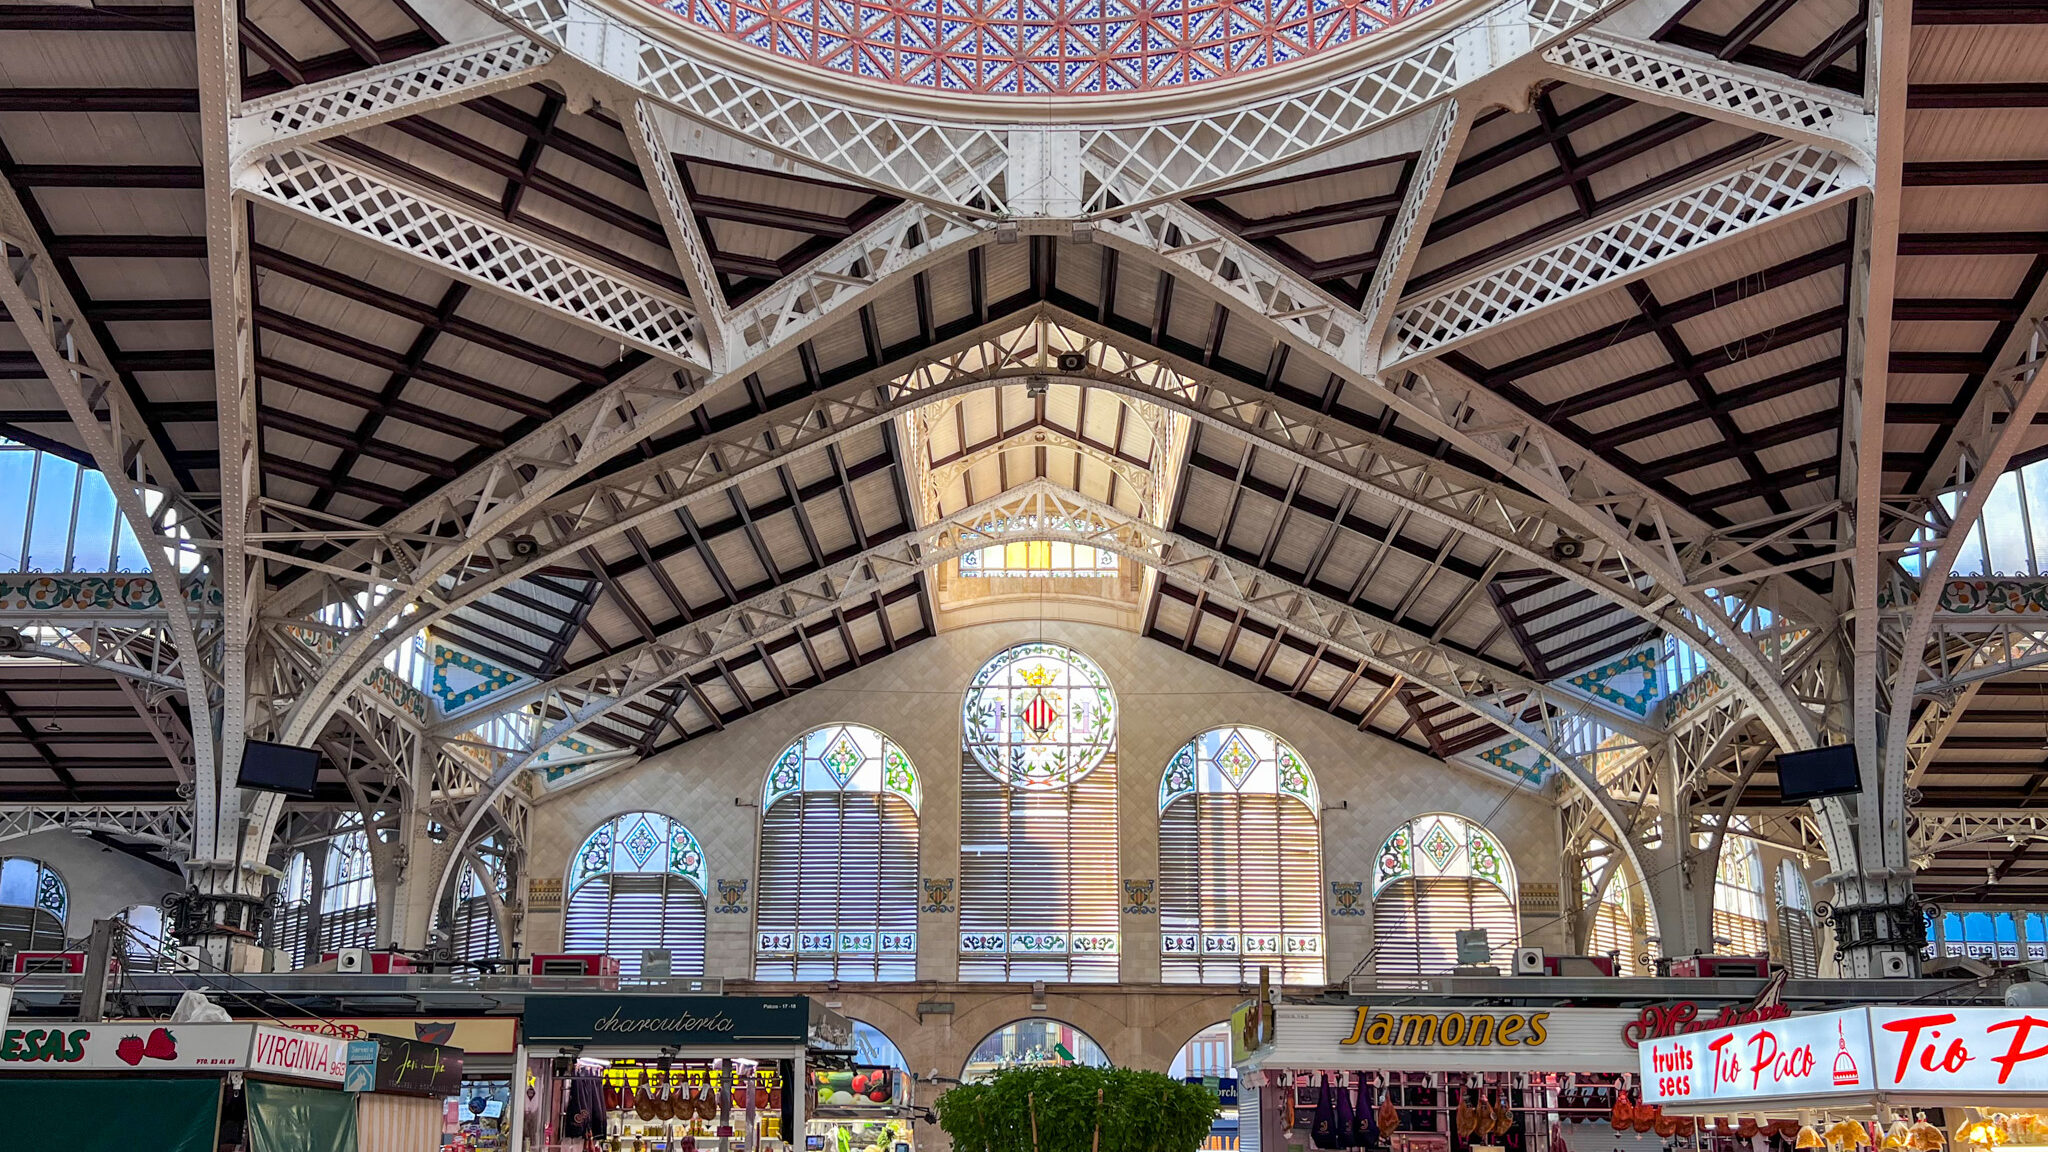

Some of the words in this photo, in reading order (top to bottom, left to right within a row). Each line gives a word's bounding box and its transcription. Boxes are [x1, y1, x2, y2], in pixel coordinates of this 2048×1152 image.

[594, 1006, 735, 1033] charcutería
[1340, 1006, 1551, 1046] Jamones
[0, 1029, 91, 1062] ESAS
[256, 1032, 329, 1073] VIRGINIA
[1652, 1041, 1693, 1074] fruits
[1707, 1032, 1742, 1094] Tio
[1747, 1028, 1817, 1091] Paco
[1882, 1013, 1976, 1085] Tio
[1217, 1085, 1238, 1097] orch
[1658, 1073, 1690, 1098] secs
